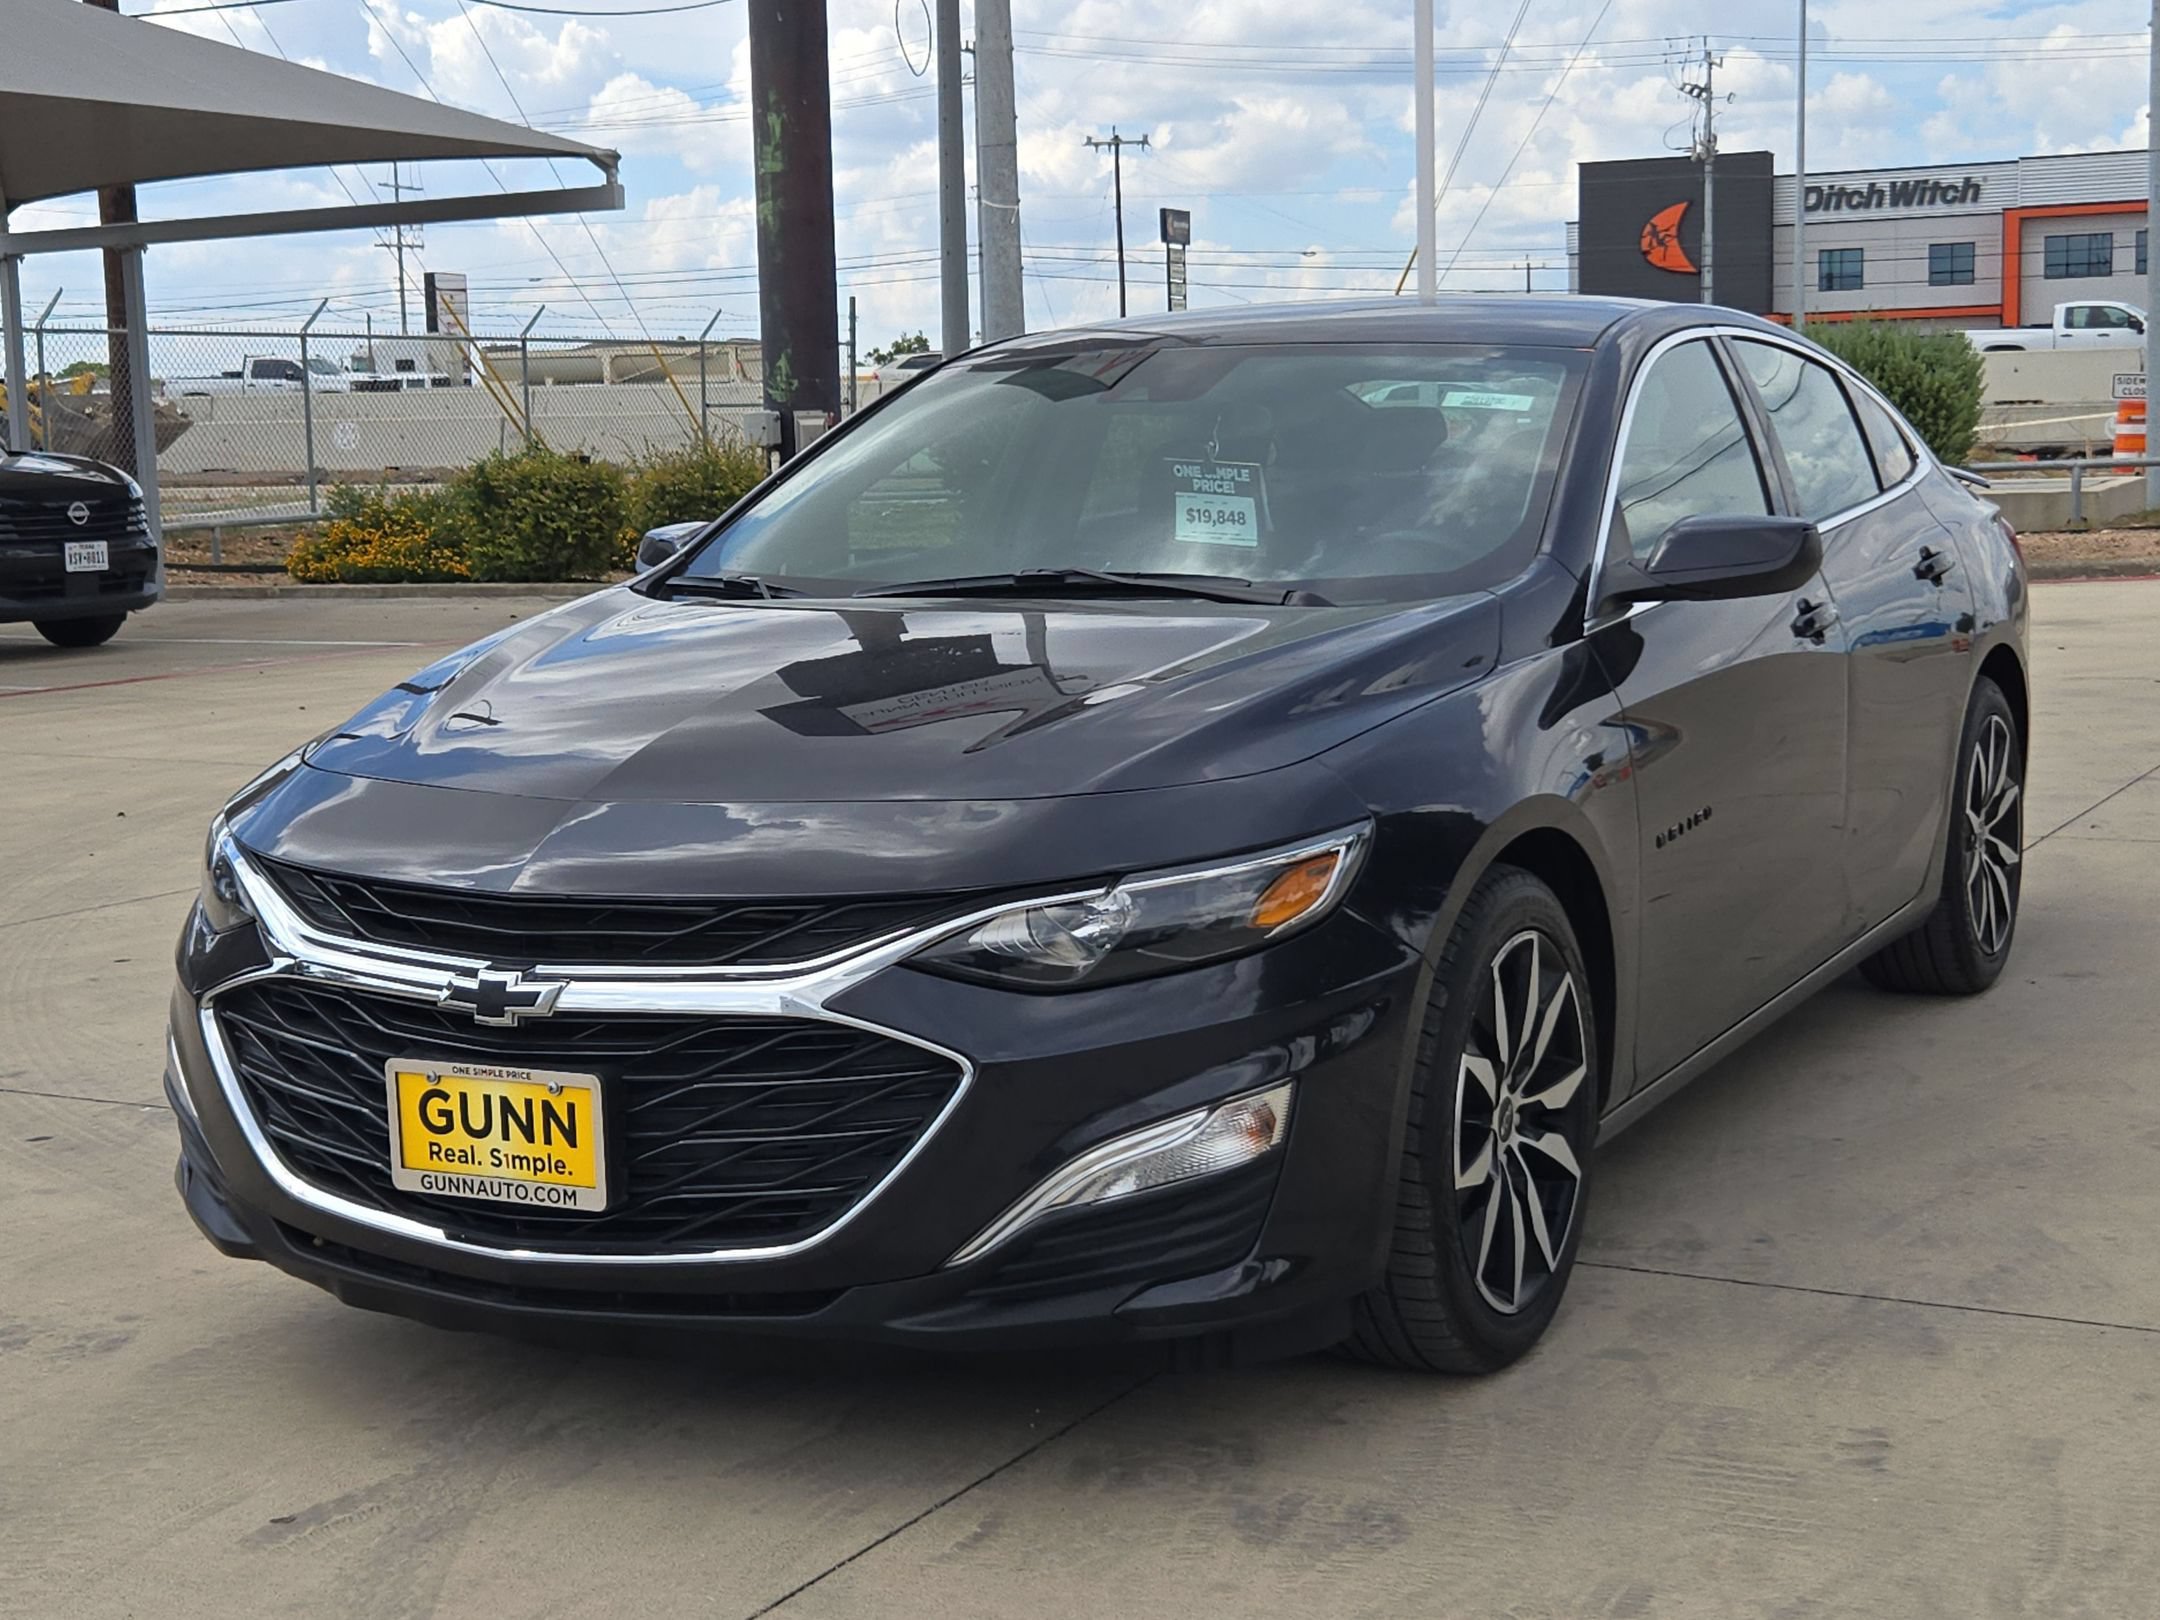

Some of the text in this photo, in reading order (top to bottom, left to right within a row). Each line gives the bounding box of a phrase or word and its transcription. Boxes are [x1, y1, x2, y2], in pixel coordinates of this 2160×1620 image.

[1804, 176, 1981, 212] Ditch Witch
[1173, 464, 1250, 482] ONE MPLE
[1192, 478, 1236, 494] PRICE!
[1185, 507, 1246, 527] $19,848
[452, 1065, 532, 1081] ONE SIMPLE PRICE
[418, 1088, 578, 1149] GUNN
[428, 1141, 483, 1167] Real.
[420, 1174, 578, 1206] GUNNAUTO.COM
